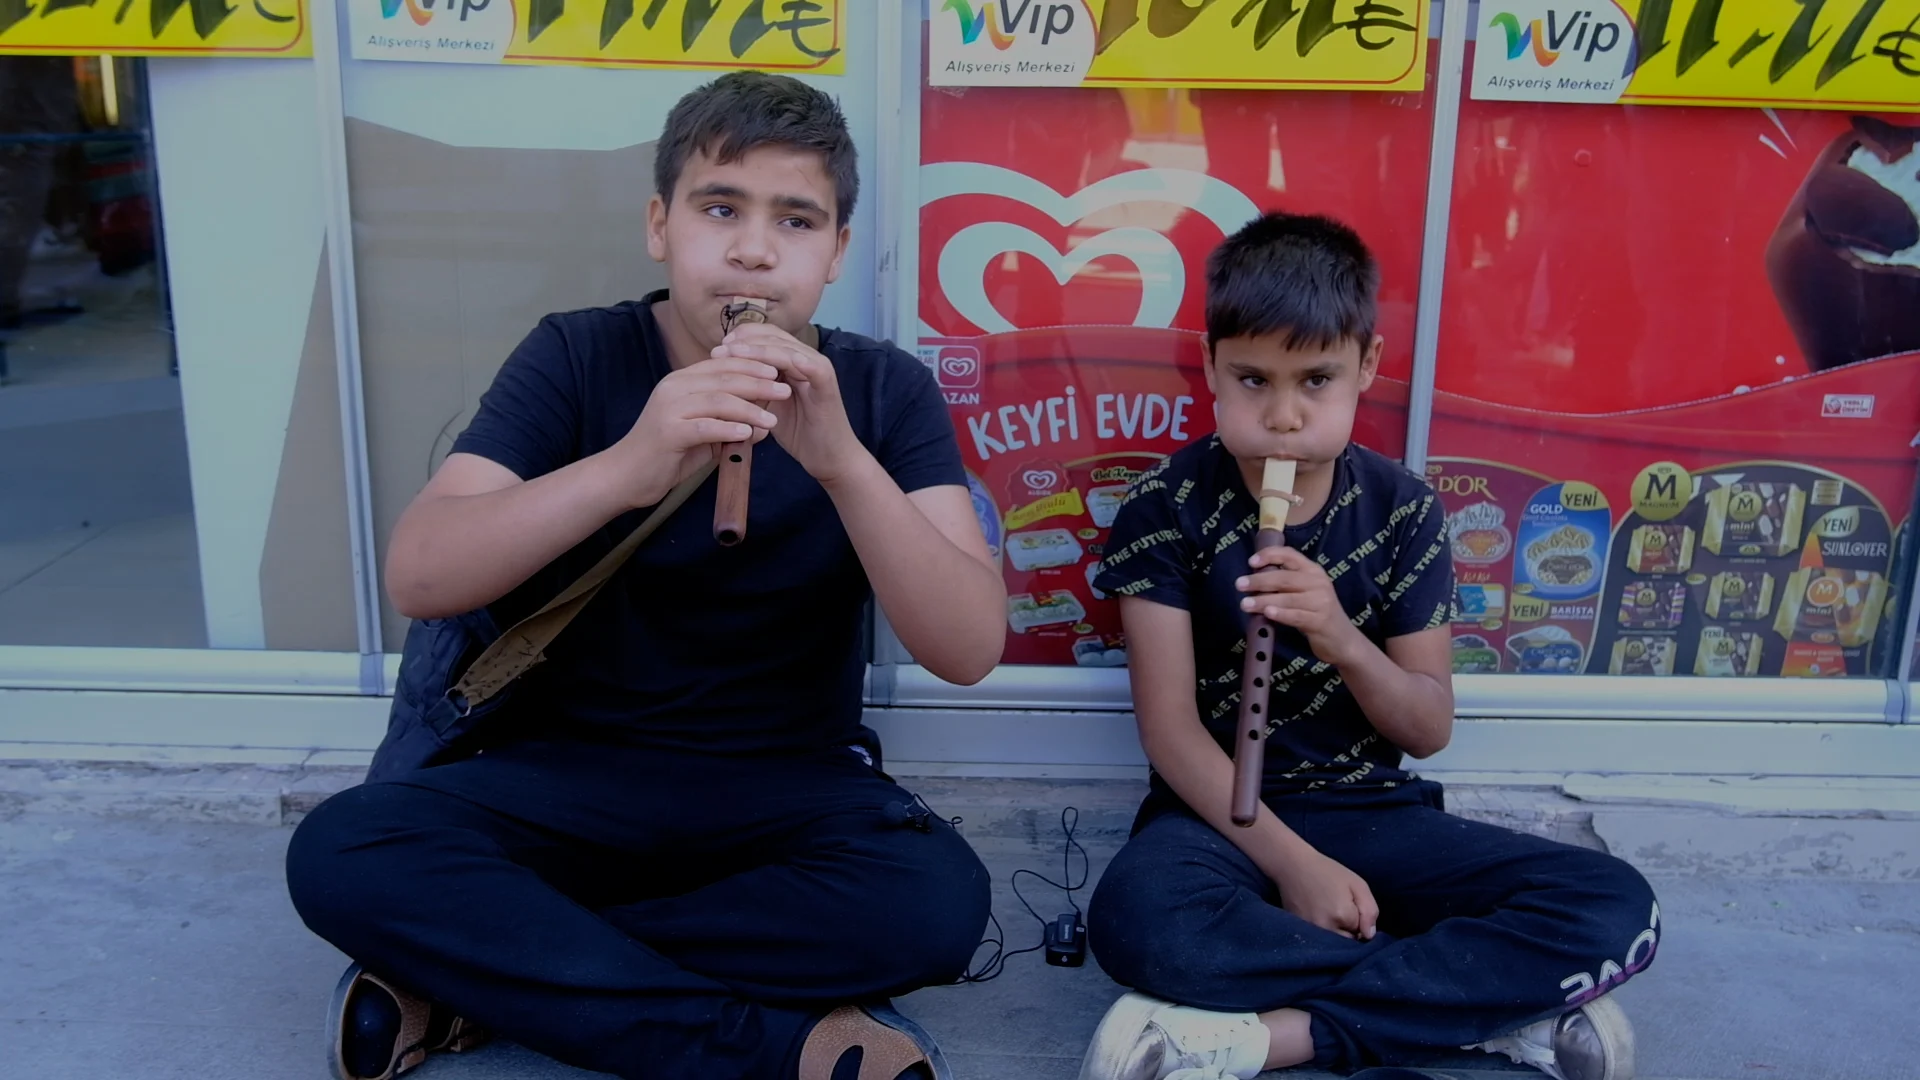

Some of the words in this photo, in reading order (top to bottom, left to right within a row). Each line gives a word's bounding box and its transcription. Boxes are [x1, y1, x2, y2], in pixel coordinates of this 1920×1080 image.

[999, 0, 1075, 45] Vip
[368, 34, 432, 50] Alışveriş
[436, 37, 496, 52] Merkezi
[1546, 10, 1620, 62] Vip
[945, 60, 1011, 75] Alışveriş
[1015, 61, 1077, 74] Merkezi
[1487, 75, 1552, 91] Alışveriş
[1556, 77, 1616, 92] Merkezi
[967, 385, 1079, 462] KEYFİ
[1096, 393, 1195, 441] EVDE
[1645, 472, 1676, 501] M
[1564, 491, 1598, 508] YENİ
[1736, 498, 1754, 513] M
[1530, 503, 1564, 515] GOLD
[1730, 523, 1755, 533] mini
[1822, 516, 1853, 532] YENİ
[1214, 530, 1240, 555] ARE
[1236, 513, 1260, 534] THE
[1105, 547, 1132, 567] THE
[1130, 528, 1183, 554] FUTURE
[1822, 541, 1888, 557] SUNLOVER
[1327, 560, 1351, 580] RE
[1347, 539, 1378, 563] THE
[1388, 572, 1419, 602] ARE
[1413, 543, 1441, 571] THE
[1423, 601, 1447, 631] URE
[1513, 603, 1544, 617] YENİ
[1551, 605, 1594, 617] BARİSTA
[1806, 606, 1832, 615] mini
[1302, 691, 1329, 717] THE
